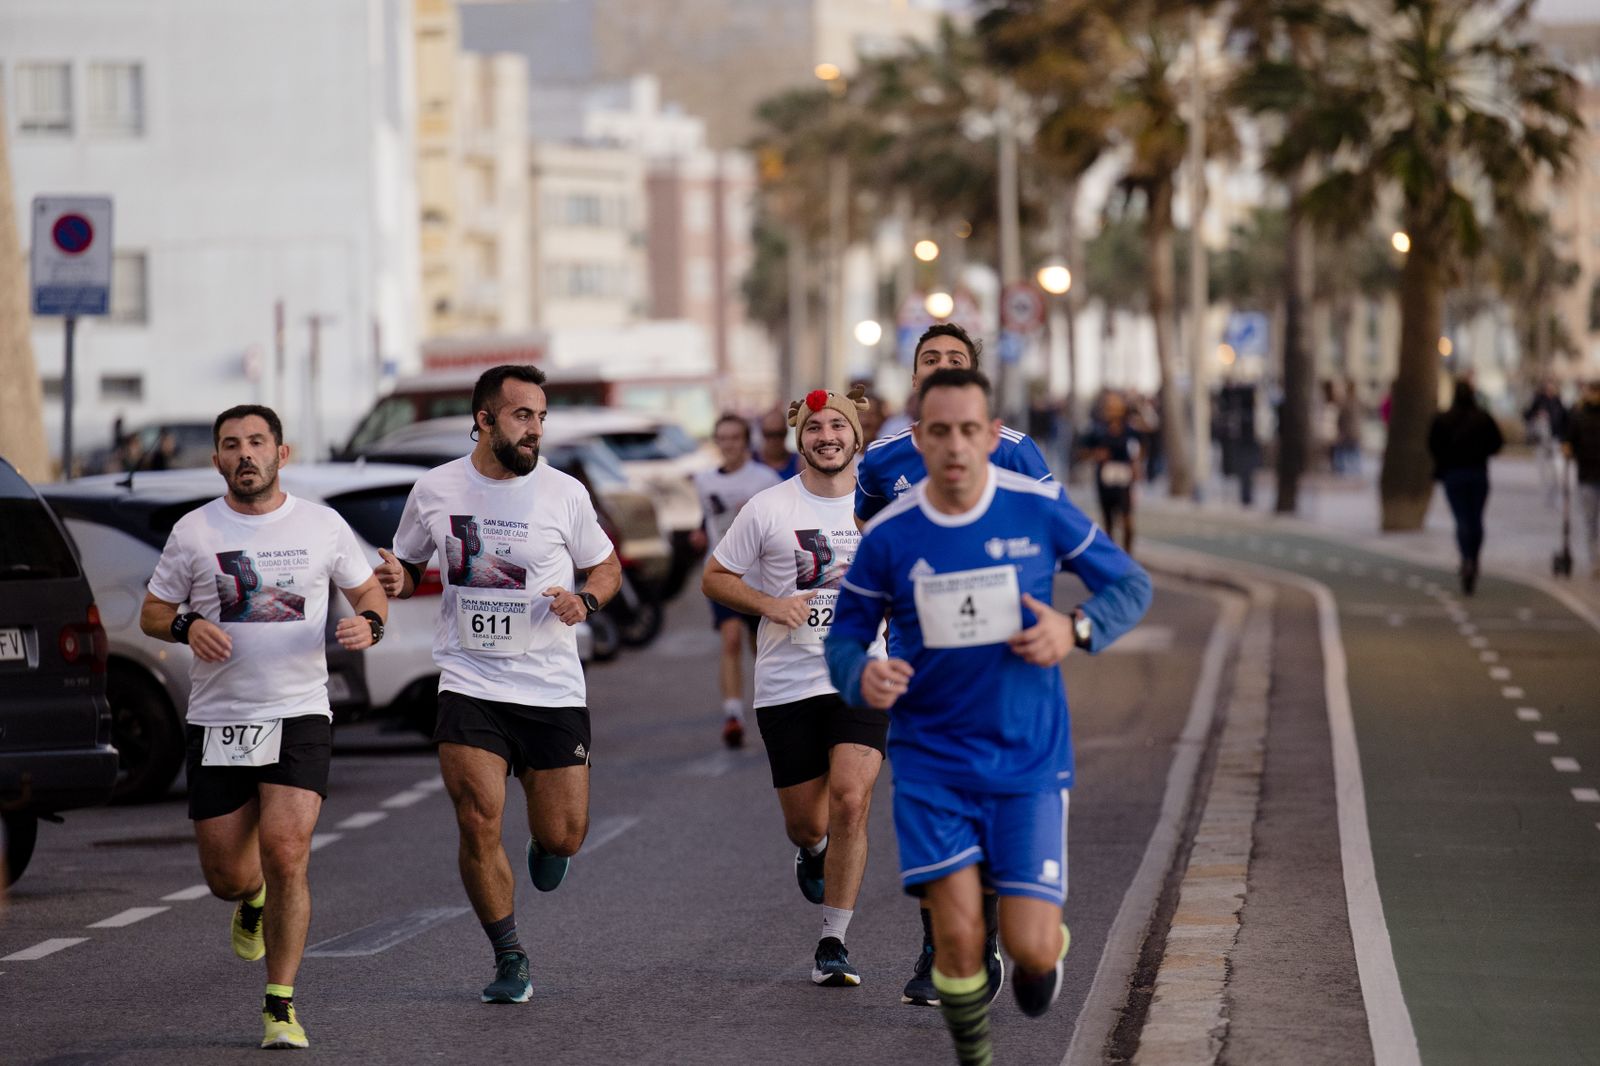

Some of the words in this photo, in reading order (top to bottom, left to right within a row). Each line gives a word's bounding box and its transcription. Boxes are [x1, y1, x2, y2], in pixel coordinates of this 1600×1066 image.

[497, 520, 529, 529] SILVESTRE
[482, 528, 503, 536] CIUDAD
[503, 529, 512, 537] DE
[512, 529, 529, 539] CÁDIZ
[273, 549, 308, 557] SILVESTRE
[461, 604, 490, 612] CIUDAD
[960, 595, 976, 617] 4
[471, 613, 511, 635] 611
[222, 725, 263, 745] 977
